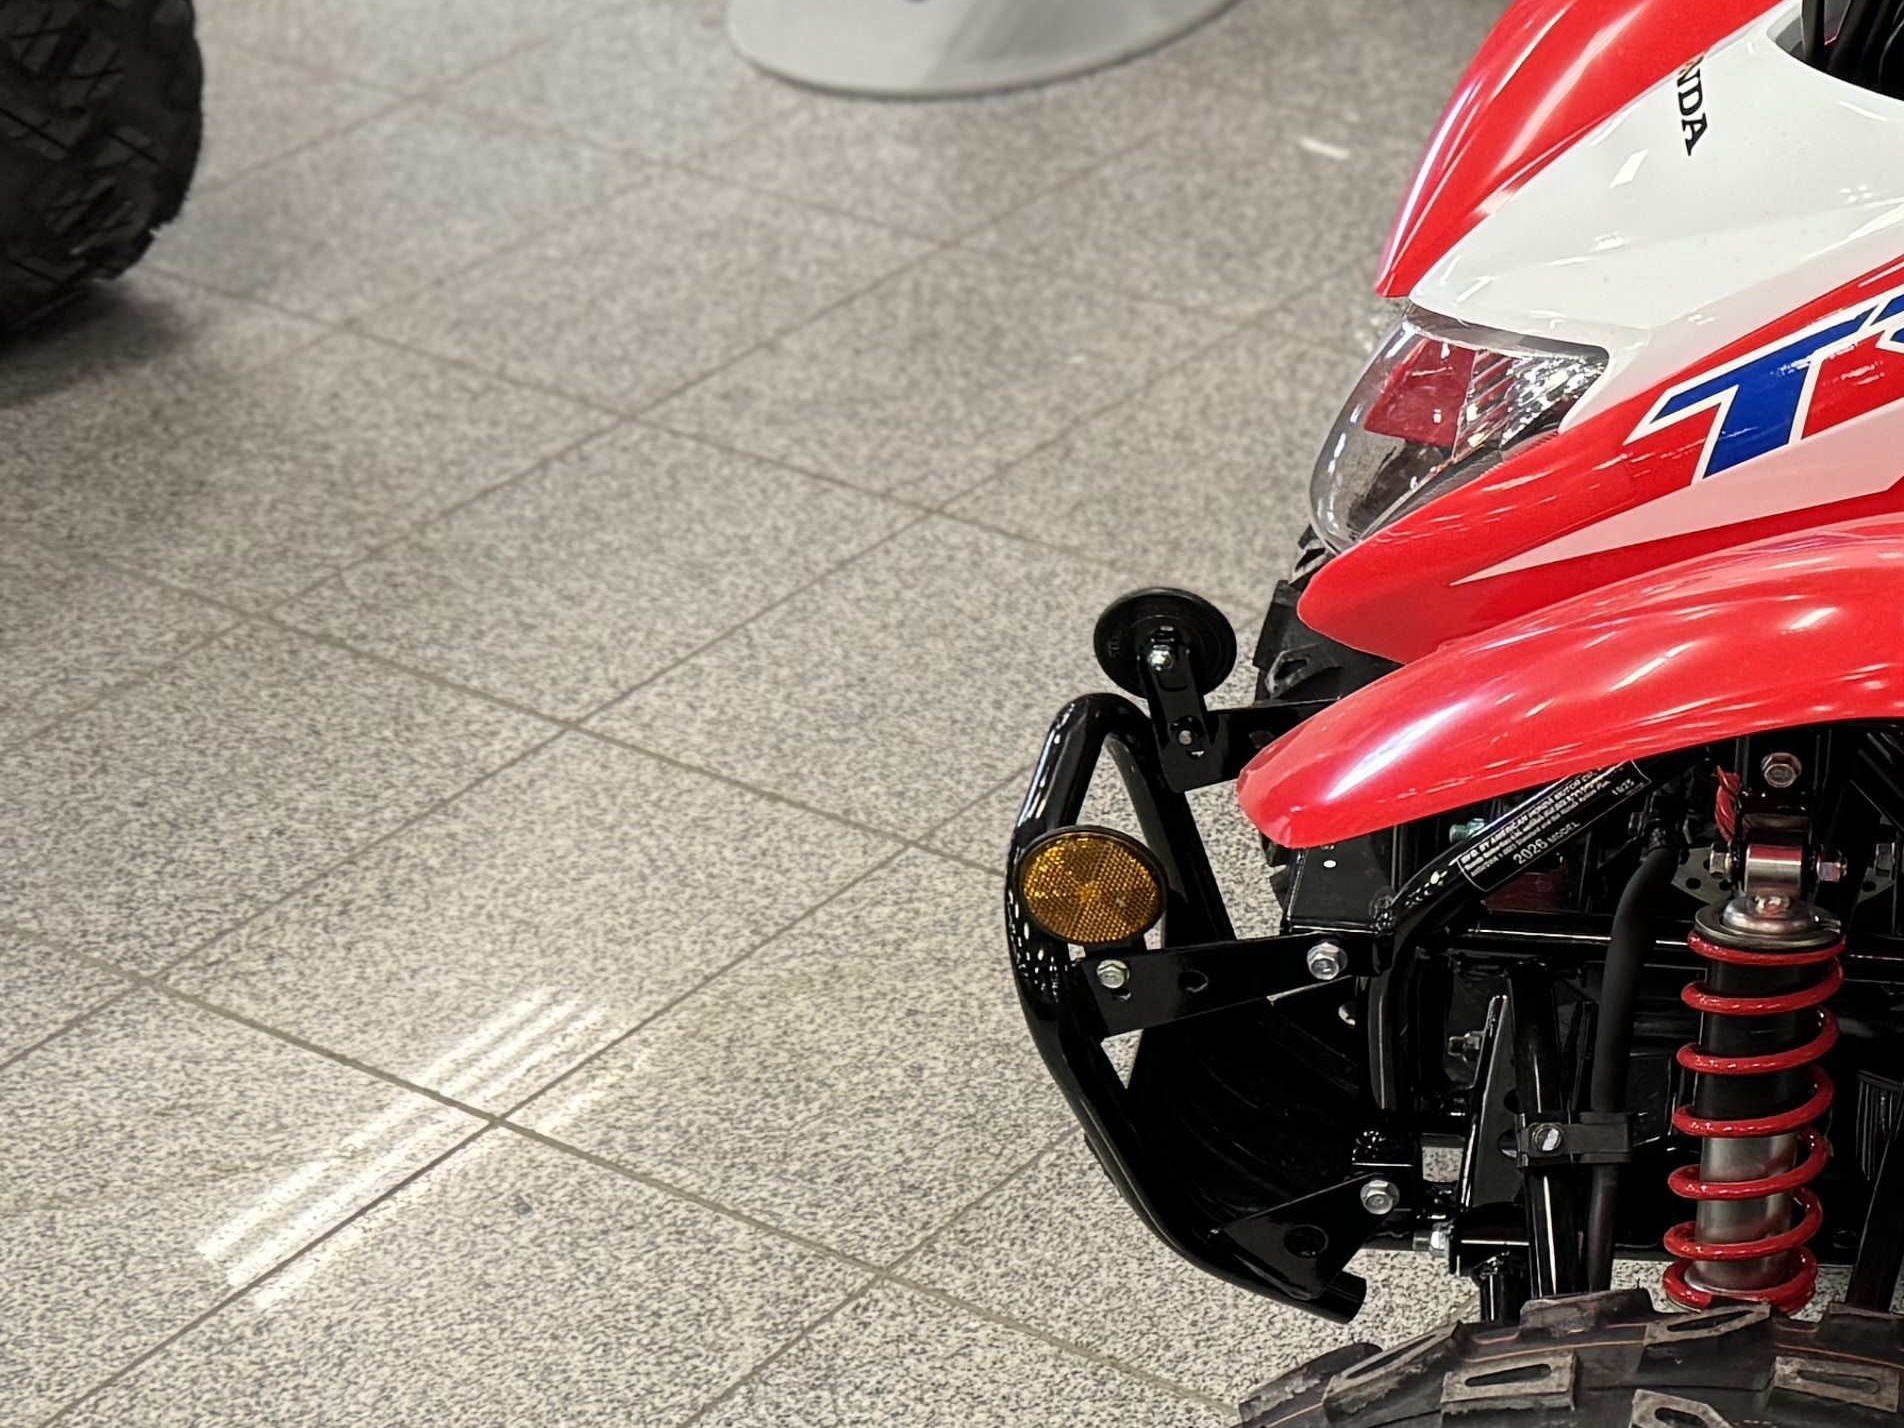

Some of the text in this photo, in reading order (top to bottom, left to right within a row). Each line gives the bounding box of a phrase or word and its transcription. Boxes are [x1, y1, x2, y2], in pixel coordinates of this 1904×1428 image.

[1676, 56, 1708, 157] NDA
[1511, 835, 1549, 866] 2026
[1546, 818, 1580, 844] MODEL
